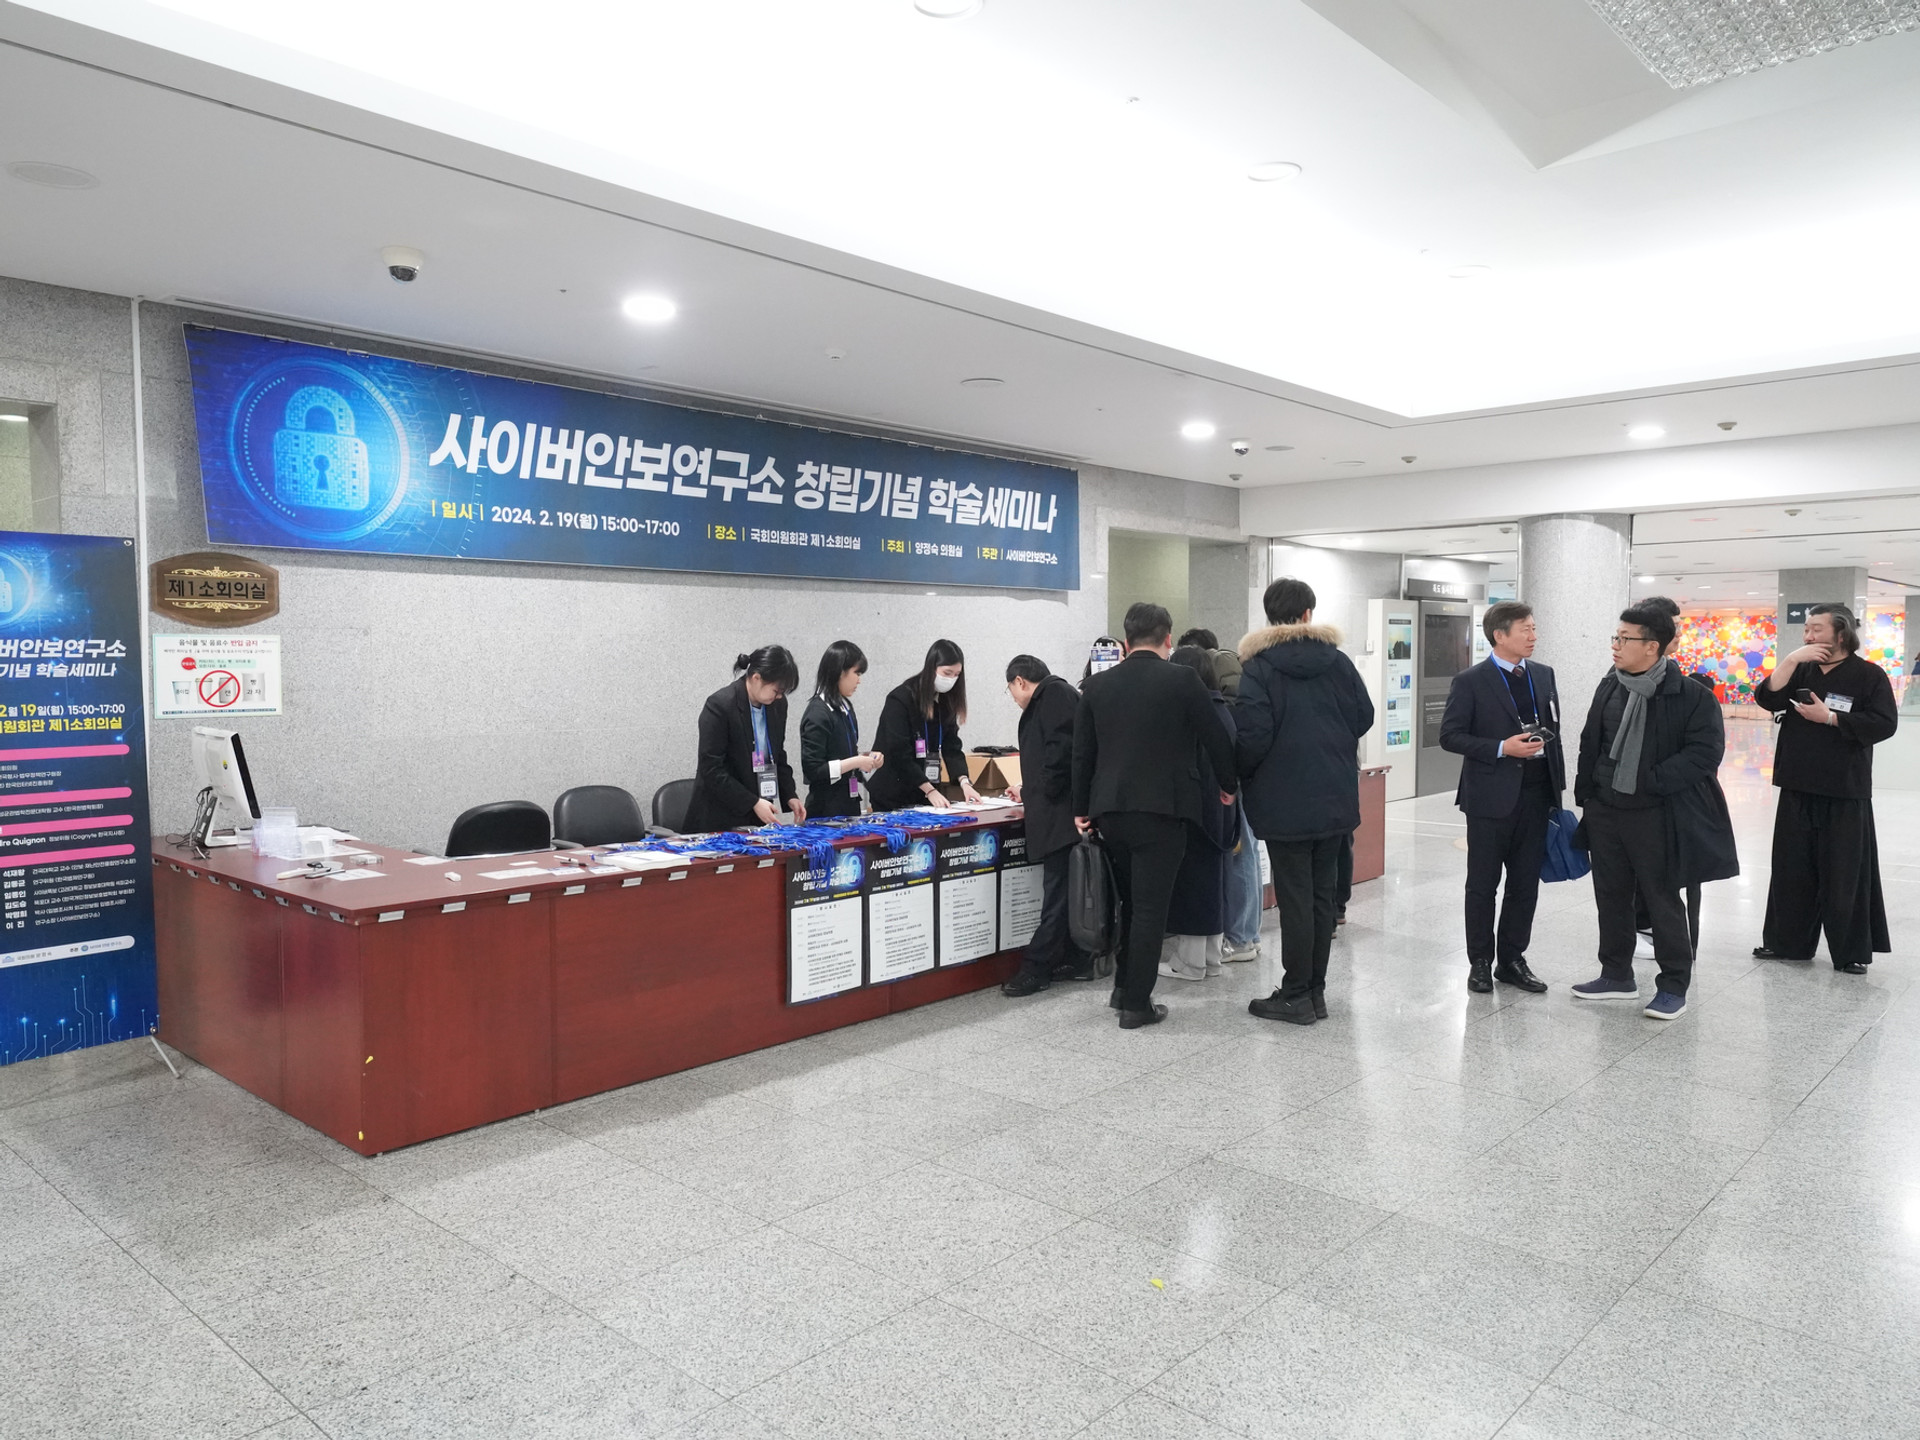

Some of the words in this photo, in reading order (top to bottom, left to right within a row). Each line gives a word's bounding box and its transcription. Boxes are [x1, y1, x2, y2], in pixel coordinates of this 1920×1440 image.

[428, 412, 785, 509] 사이버안보연구소
[793, 460, 923, 520] 창립기념
[927, 478, 1058, 533] 학술세미나
[441, 501, 473, 520] 일시
[491, 505, 537, 526] 2024.
[539, 510, 554, 526] 2.
[556, 511, 599, 531] 19(월)
[601, 515, 681, 536] 15:00~17:00
[714, 525, 737, 541] 장소
[750, 528, 808, 547] 국회의원회관
[810, 532, 861, 550] 제1소회의실
[887, 539, 904, 553] 주최
[915, 541, 939, 556] 양정숙
[940, 544, 963, 558] 의원실
[982, 547, 998, 560] 주관
[1006, 549, 1058, 565] 사이버안보연구소
[168, 578, 266, 600] 제1소회의실
[36, 662, 118, 678] 학술세미나
[20, 704, 64, 717] 19일(월)
[67, 703, 126, 715] 15:00~17:00
[0, 719, 45, 734] 원회관
[48, 717, 123, 731] 제1소회의실
[12, 837, 46, 846] Quignon
